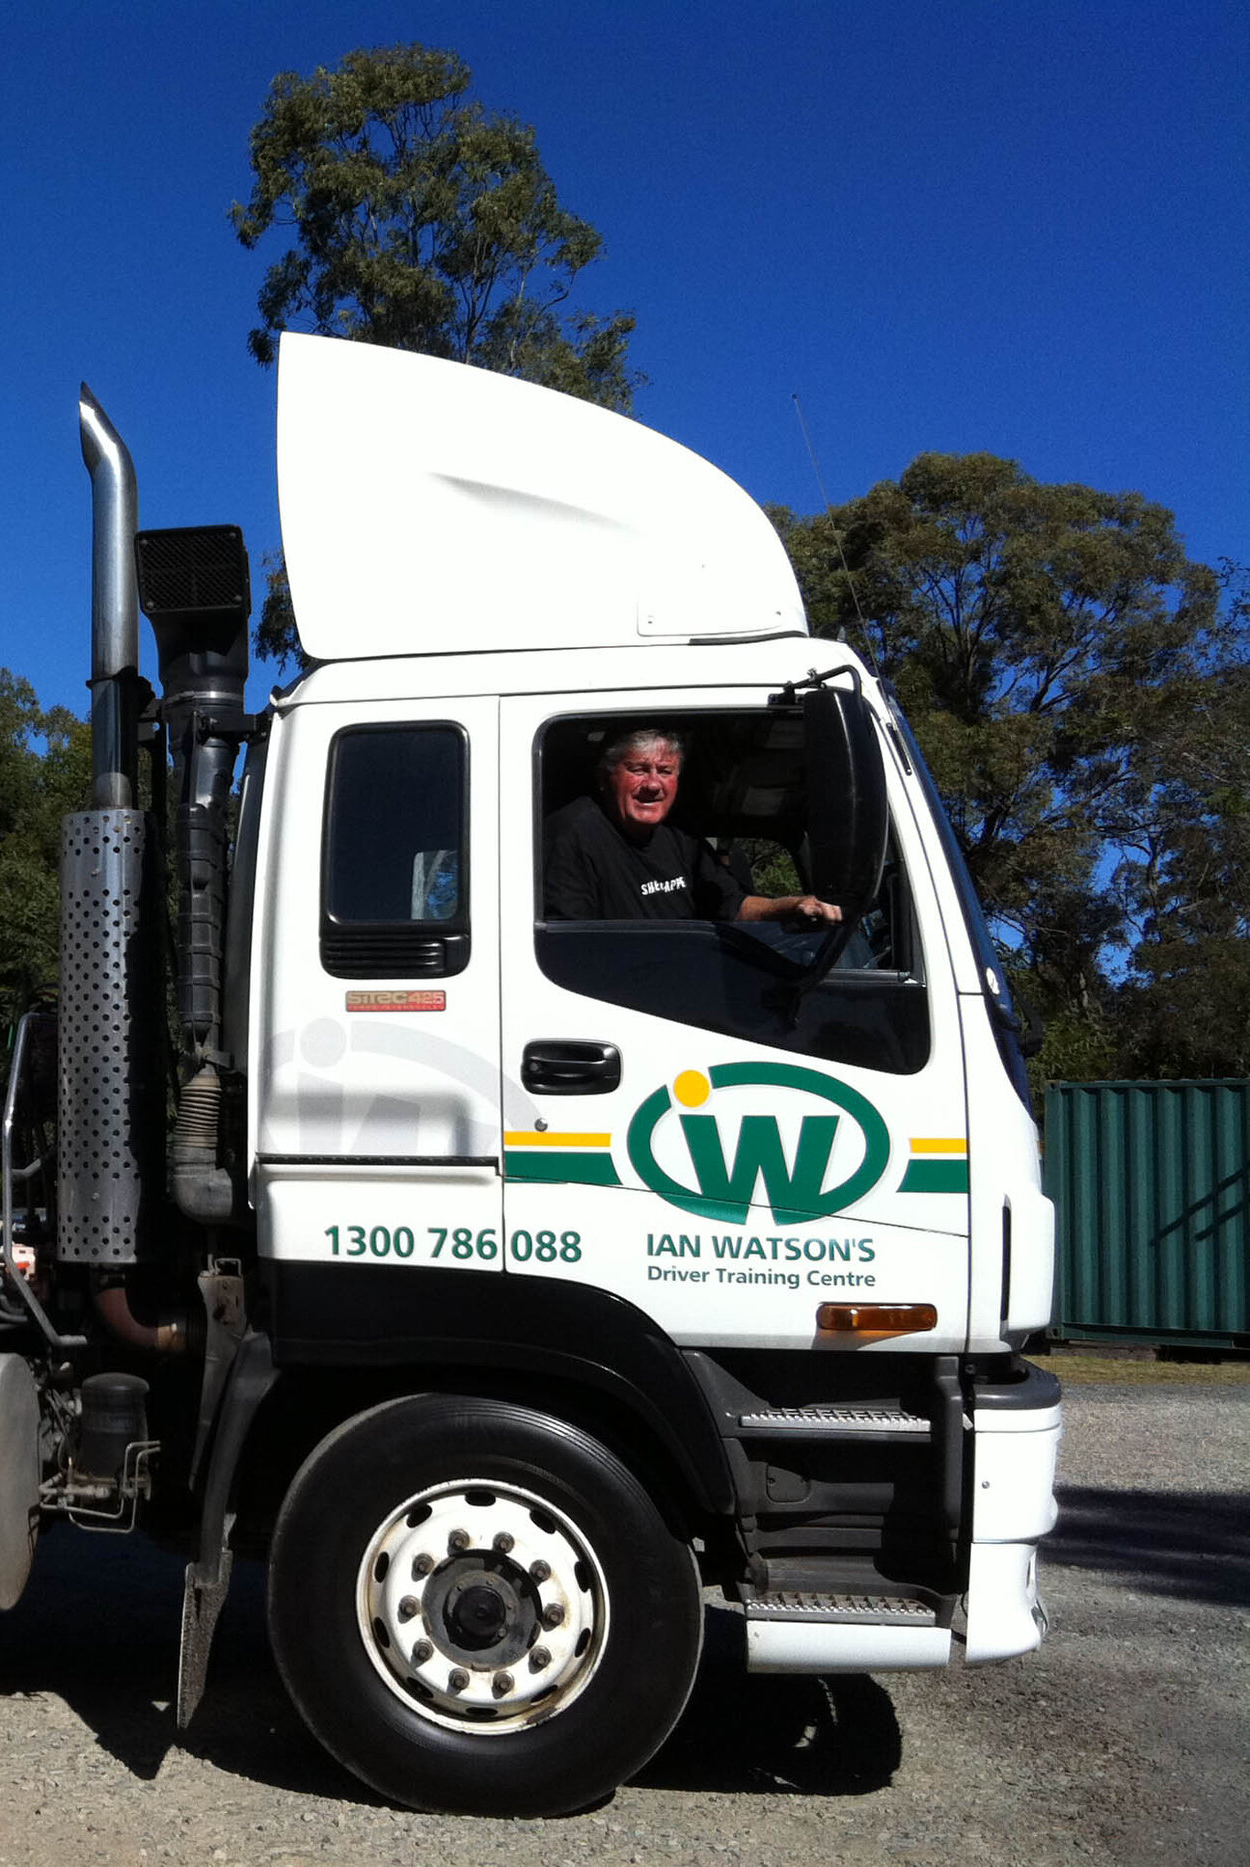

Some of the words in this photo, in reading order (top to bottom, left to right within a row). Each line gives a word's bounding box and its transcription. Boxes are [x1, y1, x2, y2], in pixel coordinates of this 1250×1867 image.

[324, 1226, 415, 1258] 1300
[427, 1227, 498, 1260] 786
[511, 1229, 582, 1263] 088
[646, 1233, 701, 1258] IAN
[711, 1235, 876, 1262] WATSON'S
[647, 1265, 710, 1283] Driver
[715, 1267, 800, 1289] Training
[806, 1270, 876, 1287] Centre
